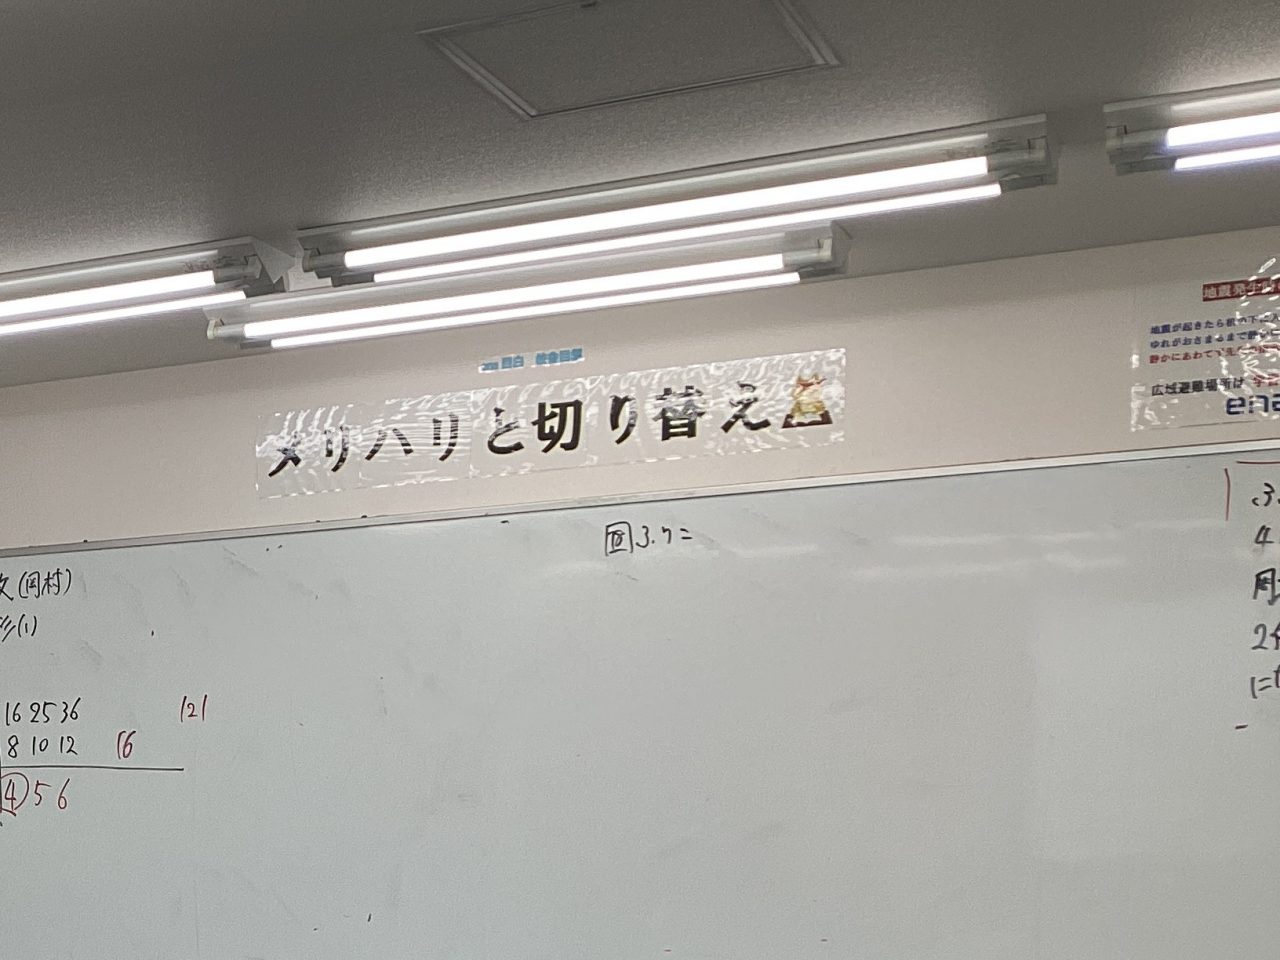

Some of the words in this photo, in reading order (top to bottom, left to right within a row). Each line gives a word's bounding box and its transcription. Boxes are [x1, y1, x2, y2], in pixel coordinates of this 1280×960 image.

[269, 380, 771, 477] メリハリと切り替え
[5, 702, 21, 726] 16
[30, 702, 57, 723] 25
[60, 697, 81, 723] 36
[180, 695, 208, 722] 121
[8, 735, 19, 758] 8
[32, 736, 49, 755] 10
[60, 736, 78, 755] 12
[117, 730, 137, 759] 16
[34, 780, 52, 806] 5
[58, 778, 70, 809] 6
